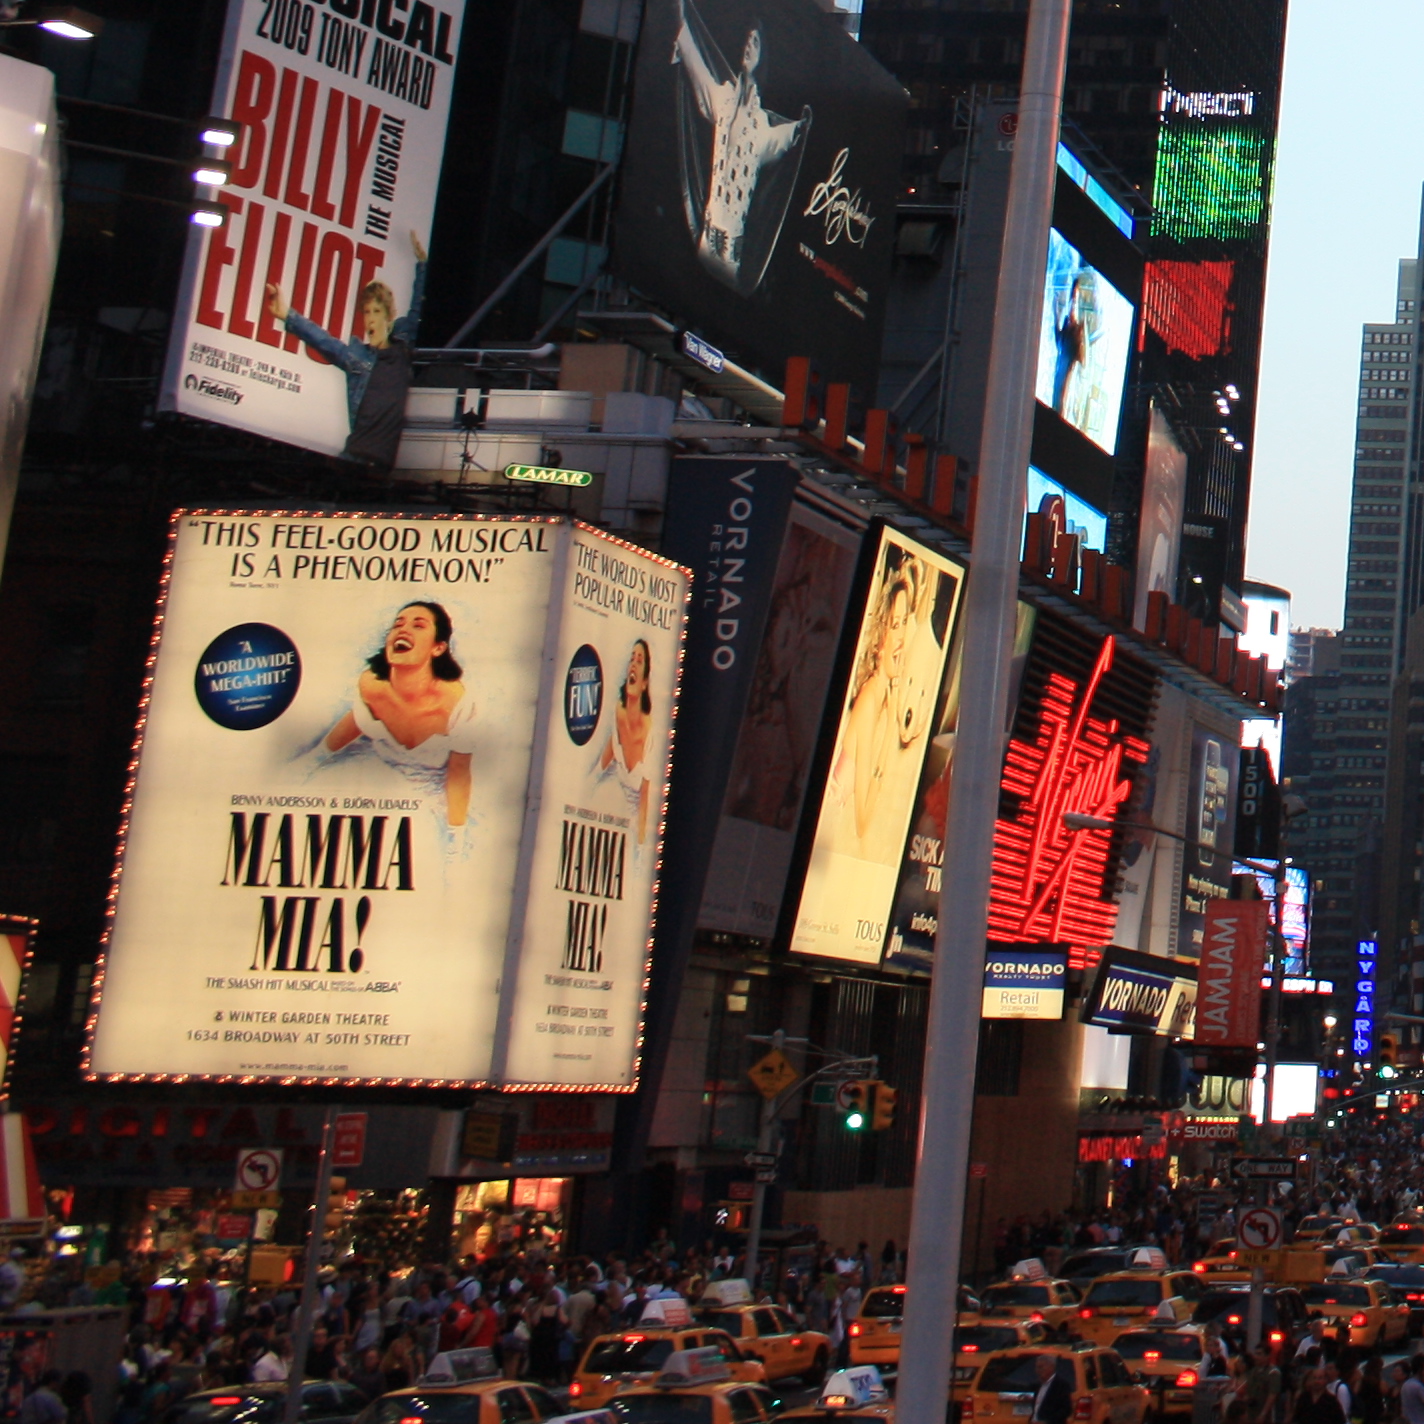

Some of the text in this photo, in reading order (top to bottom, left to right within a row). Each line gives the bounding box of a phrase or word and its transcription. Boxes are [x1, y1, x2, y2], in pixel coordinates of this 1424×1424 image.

[317, 12, 366, 79] TONY
[369, 38, 434, 110] AWARD
[229, 51, 381, 229] BILLY
[364, 114, 406, 238] THE MUSICAL
[196, 192, 383, 367] ELLIOT
[198, 380, 244, 405] Fidelity
[512, 466, 585, 484] LAMAR
[189, 520, 550, 553] “THIS FEEL-GOOD MUSICAL
[231, 552, 282, 578] IS A
[701, 523, 723, 611] RETAIL
[711, 466, 758, 671] VORNADO
[574, 572, 623, 613] POPULAR
[203, 651, 294, 676] WORLDWIDE
[231, 795, 265, 806] BENNY
[267, 797, 325, 808] ANDERSSON
[330, 798, 338, 808] &
[220, 812, 415, 891] MAMMA
[555, 820, 626, 900] MAMMA
[250, 895, 372, 973] MIA!
[561, 900, 607, 973] MIA!
[855, 919, 883, 942] TOUS
[206, 977, 226, 988] THE
[228, 978, 263, 989] SMASH
[267, 979, 282, 990] HIT
[286, 979, 330, 991] MUSICAL
[1203, 917, 1238, 1039] JAMJAM
[1000, 991, 1039, 1005] Retail
[1100, 977, 1167, 1017] VORNADO
[229, 1011, 390, 1025] WINTER GARDEN THEATRE
[188, 1030, 411, 1046] 1634 BROADWAY AT 50TH STREET
[1184, 1125, 1235, 1138] swatch
[1240, 1164, 1289, 1173] ONE WAY
